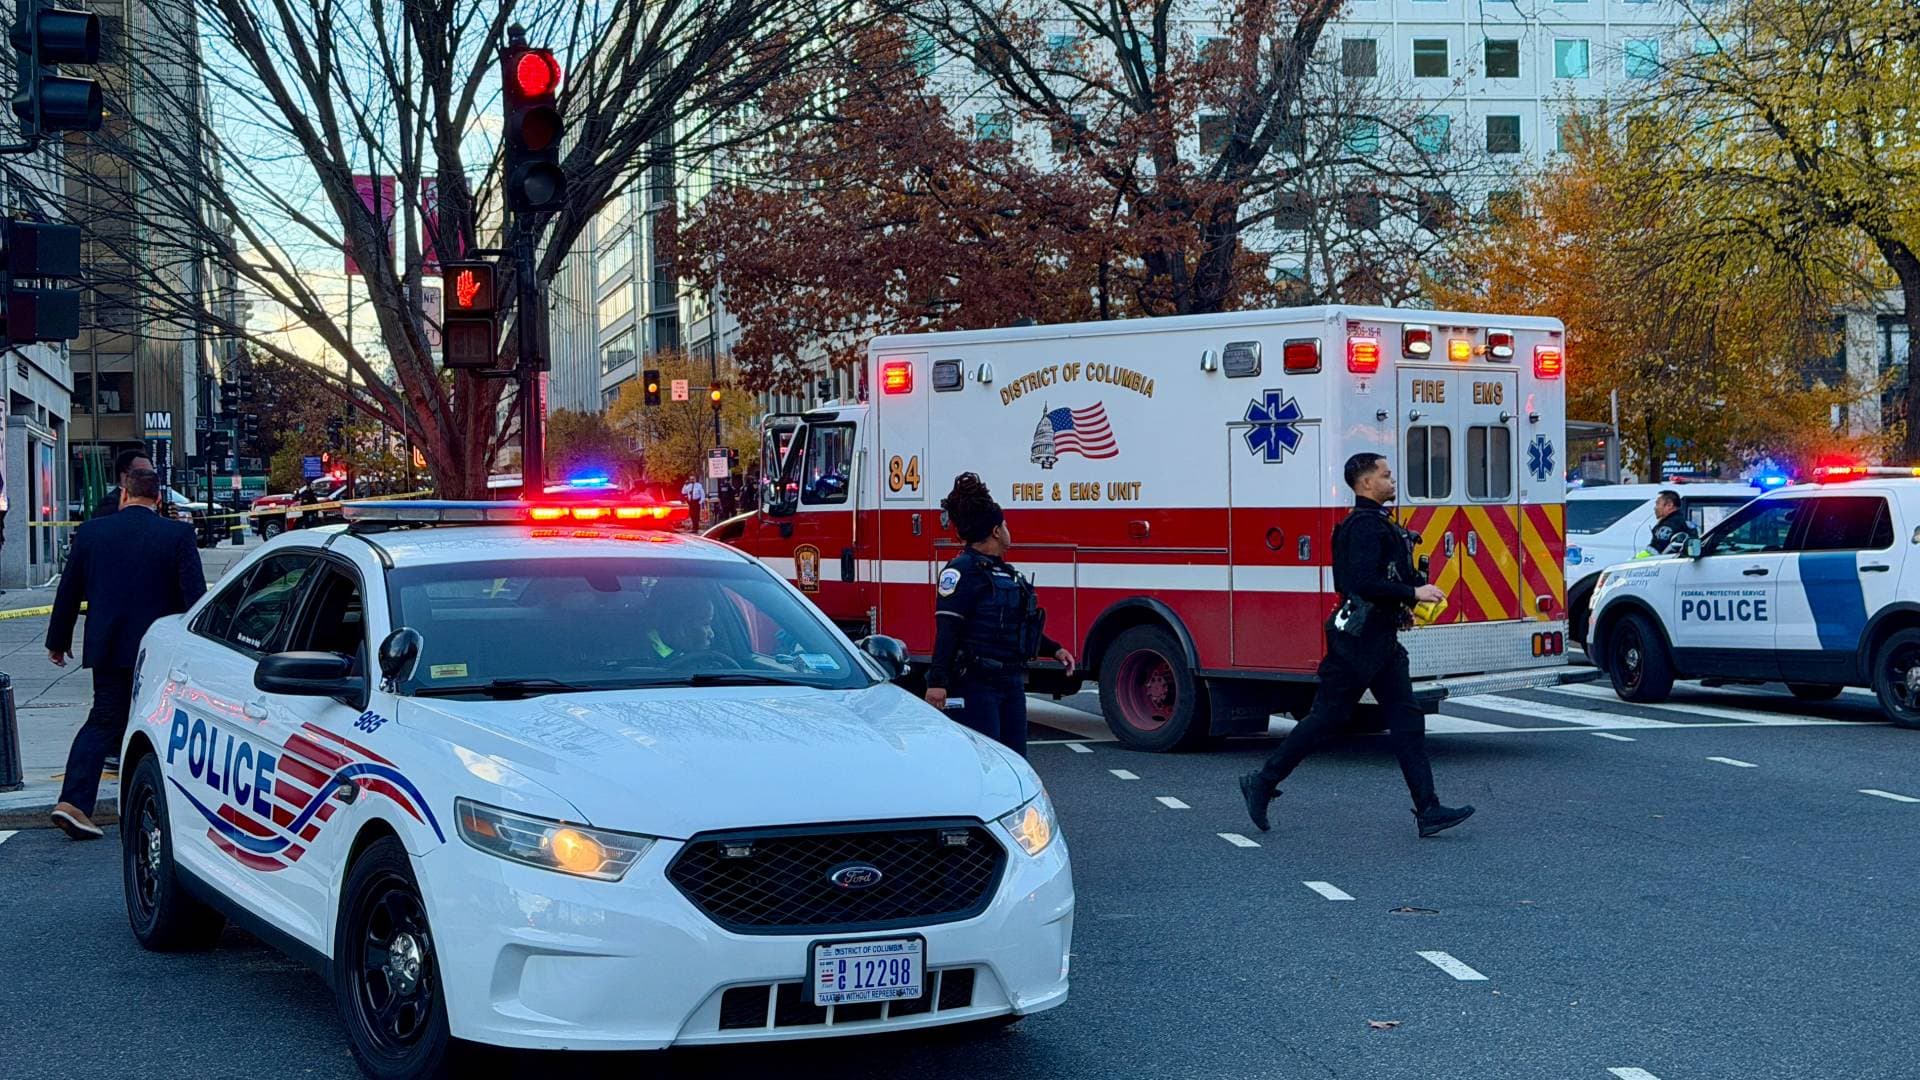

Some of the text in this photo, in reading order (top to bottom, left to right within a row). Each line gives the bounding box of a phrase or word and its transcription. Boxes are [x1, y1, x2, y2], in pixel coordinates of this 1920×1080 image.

[1000, 361, 1154, 406] DISTRICT OF COLUMBIA
[1412, 379, 1445, 403] FIRE
[1473, 381, 1503, 405] EMS
[889, 455, 921, 492] 84
[1012, 481, 1142, 501] FIRE & EMS UNIT
[1681, 599, 1768, 621] POLICE
[354, 710, 389, 734] 985
[166, 707, 277, 819] POLICE
[845, 870, 872, 883] Ford
[834, 946, 861, 956] DISTRICT
[863, 945, 871, 953] OF
[872, 944, 903, 953] COLUMBIA
[854, 958, 910, 988] 12298
[819, 987, 919, 1002] TAXATN WITHOUT REPRESEATION
